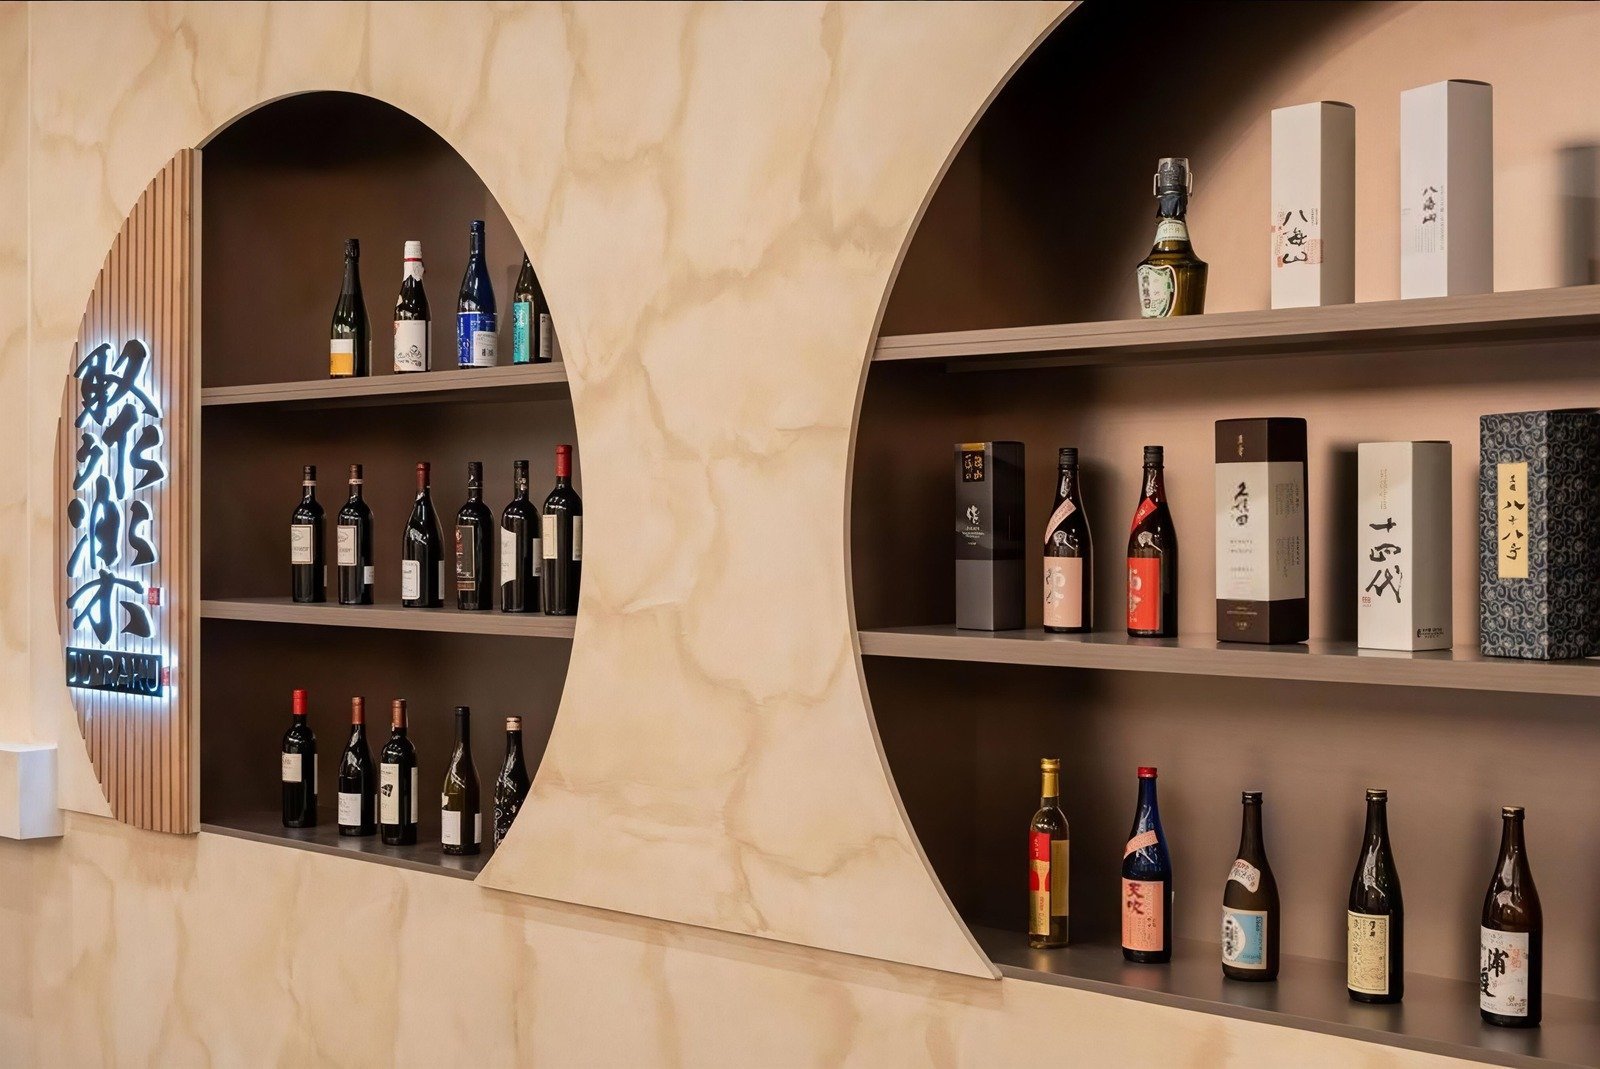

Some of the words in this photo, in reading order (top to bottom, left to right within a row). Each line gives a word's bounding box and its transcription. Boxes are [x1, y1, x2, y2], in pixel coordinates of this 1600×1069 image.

[1365, 517, 1404, 604] 十四代
[69, 651, 159, 692] JURAKU
[1127, 882, 1145, 915] 天吹
